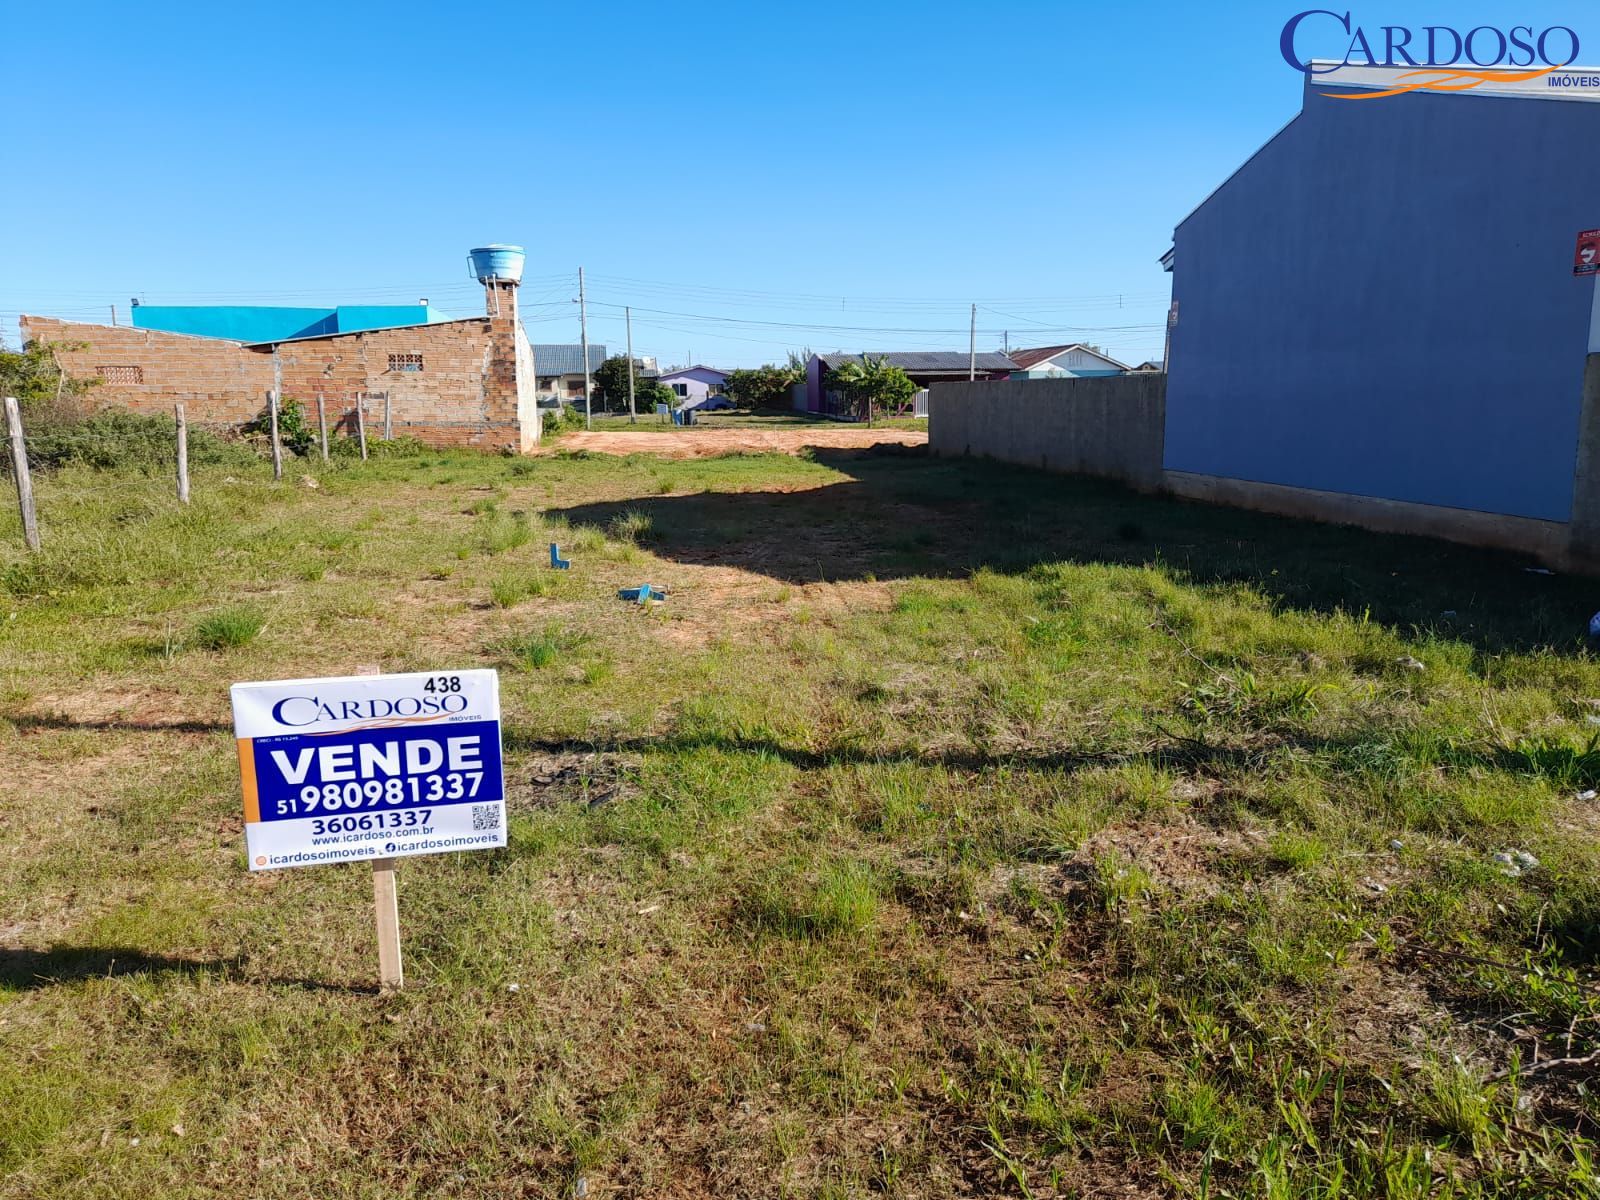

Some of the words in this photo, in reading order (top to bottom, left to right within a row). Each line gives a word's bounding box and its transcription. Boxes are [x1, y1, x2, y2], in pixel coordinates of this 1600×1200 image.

[424, 676, 462, 694] 438
[271, 694, 468, 727] CARDOSO
[270, 735, 483, 785] VENDE
[276, 799, 298, 815] 51
[300, 772, 484, 812] 980981337
[311, 809, 433, 836] 36061337
[311, 825, 435, 846] www.icardoso.com.br
[397, 832, 499, 852] icardosoimoveis
[269, 845, 376, 865] icardosoimoveis
